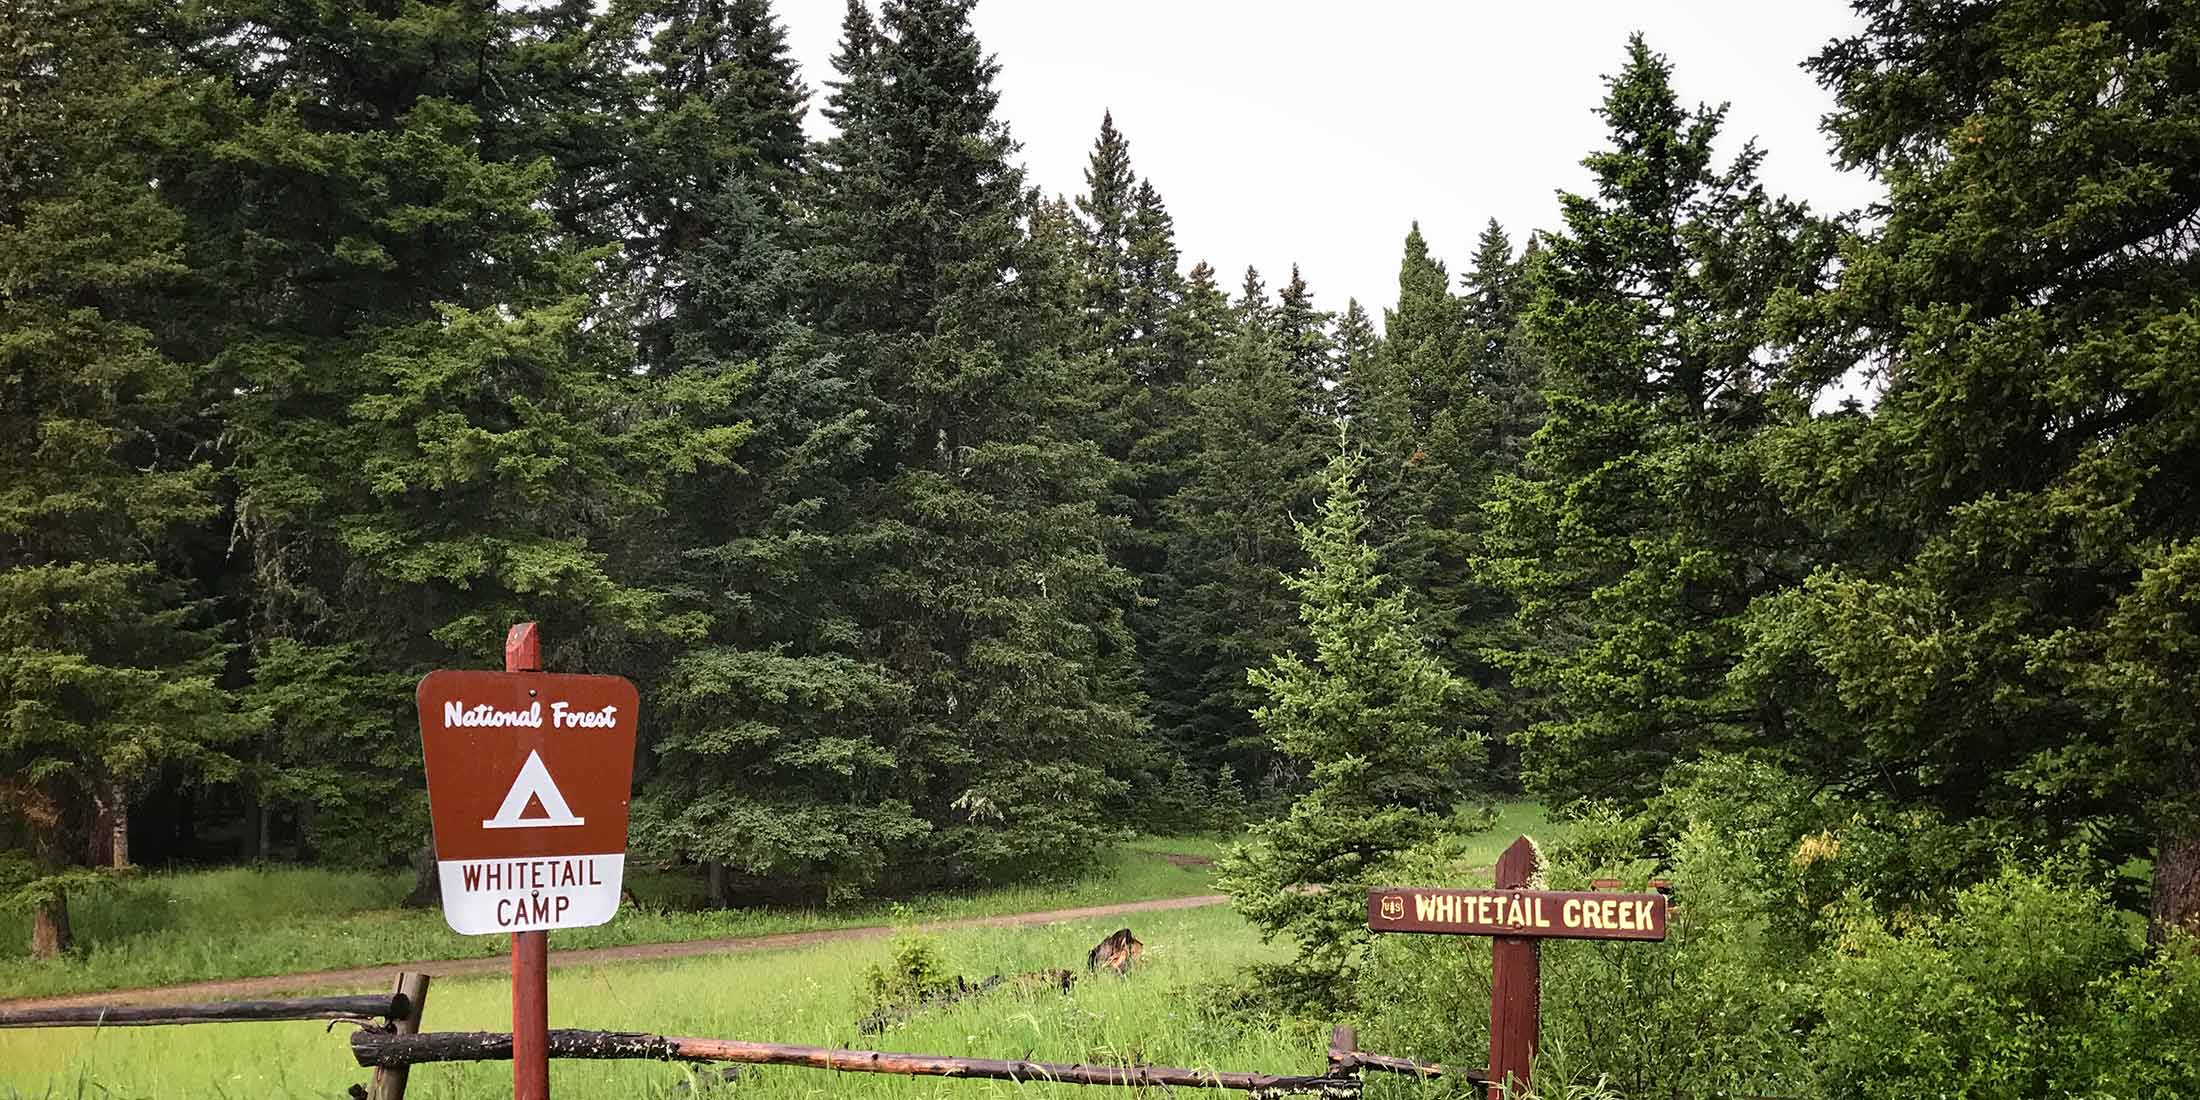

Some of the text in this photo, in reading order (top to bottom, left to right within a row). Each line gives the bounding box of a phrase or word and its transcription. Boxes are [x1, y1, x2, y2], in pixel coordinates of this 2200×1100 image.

[444, 701, 617, 728] National Forest
[462, 859, 602, 892] WHITETAIL
[497, 896, 570, 926] CAMP
[1415, 894, 1655, 931] WHITETAIL CREEK
